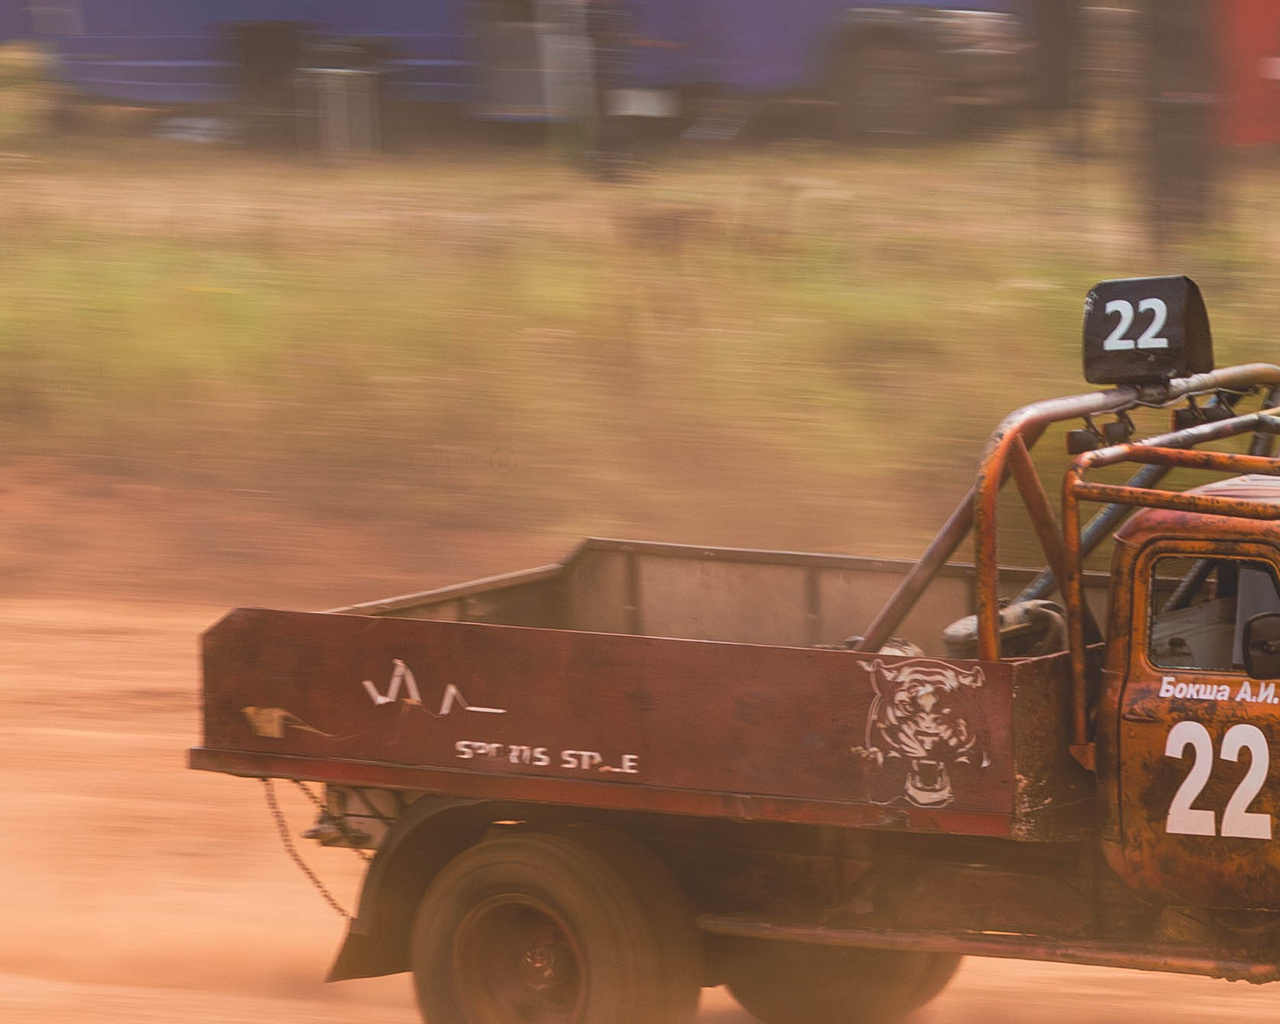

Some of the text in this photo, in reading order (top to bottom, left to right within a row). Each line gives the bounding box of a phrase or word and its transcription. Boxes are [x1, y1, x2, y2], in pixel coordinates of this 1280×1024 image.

[1103, 297, 1169, 351] 22
[1159, 676, 1279, 704] Бокша А.И.
[1164, 720, 1272, 840] 22
